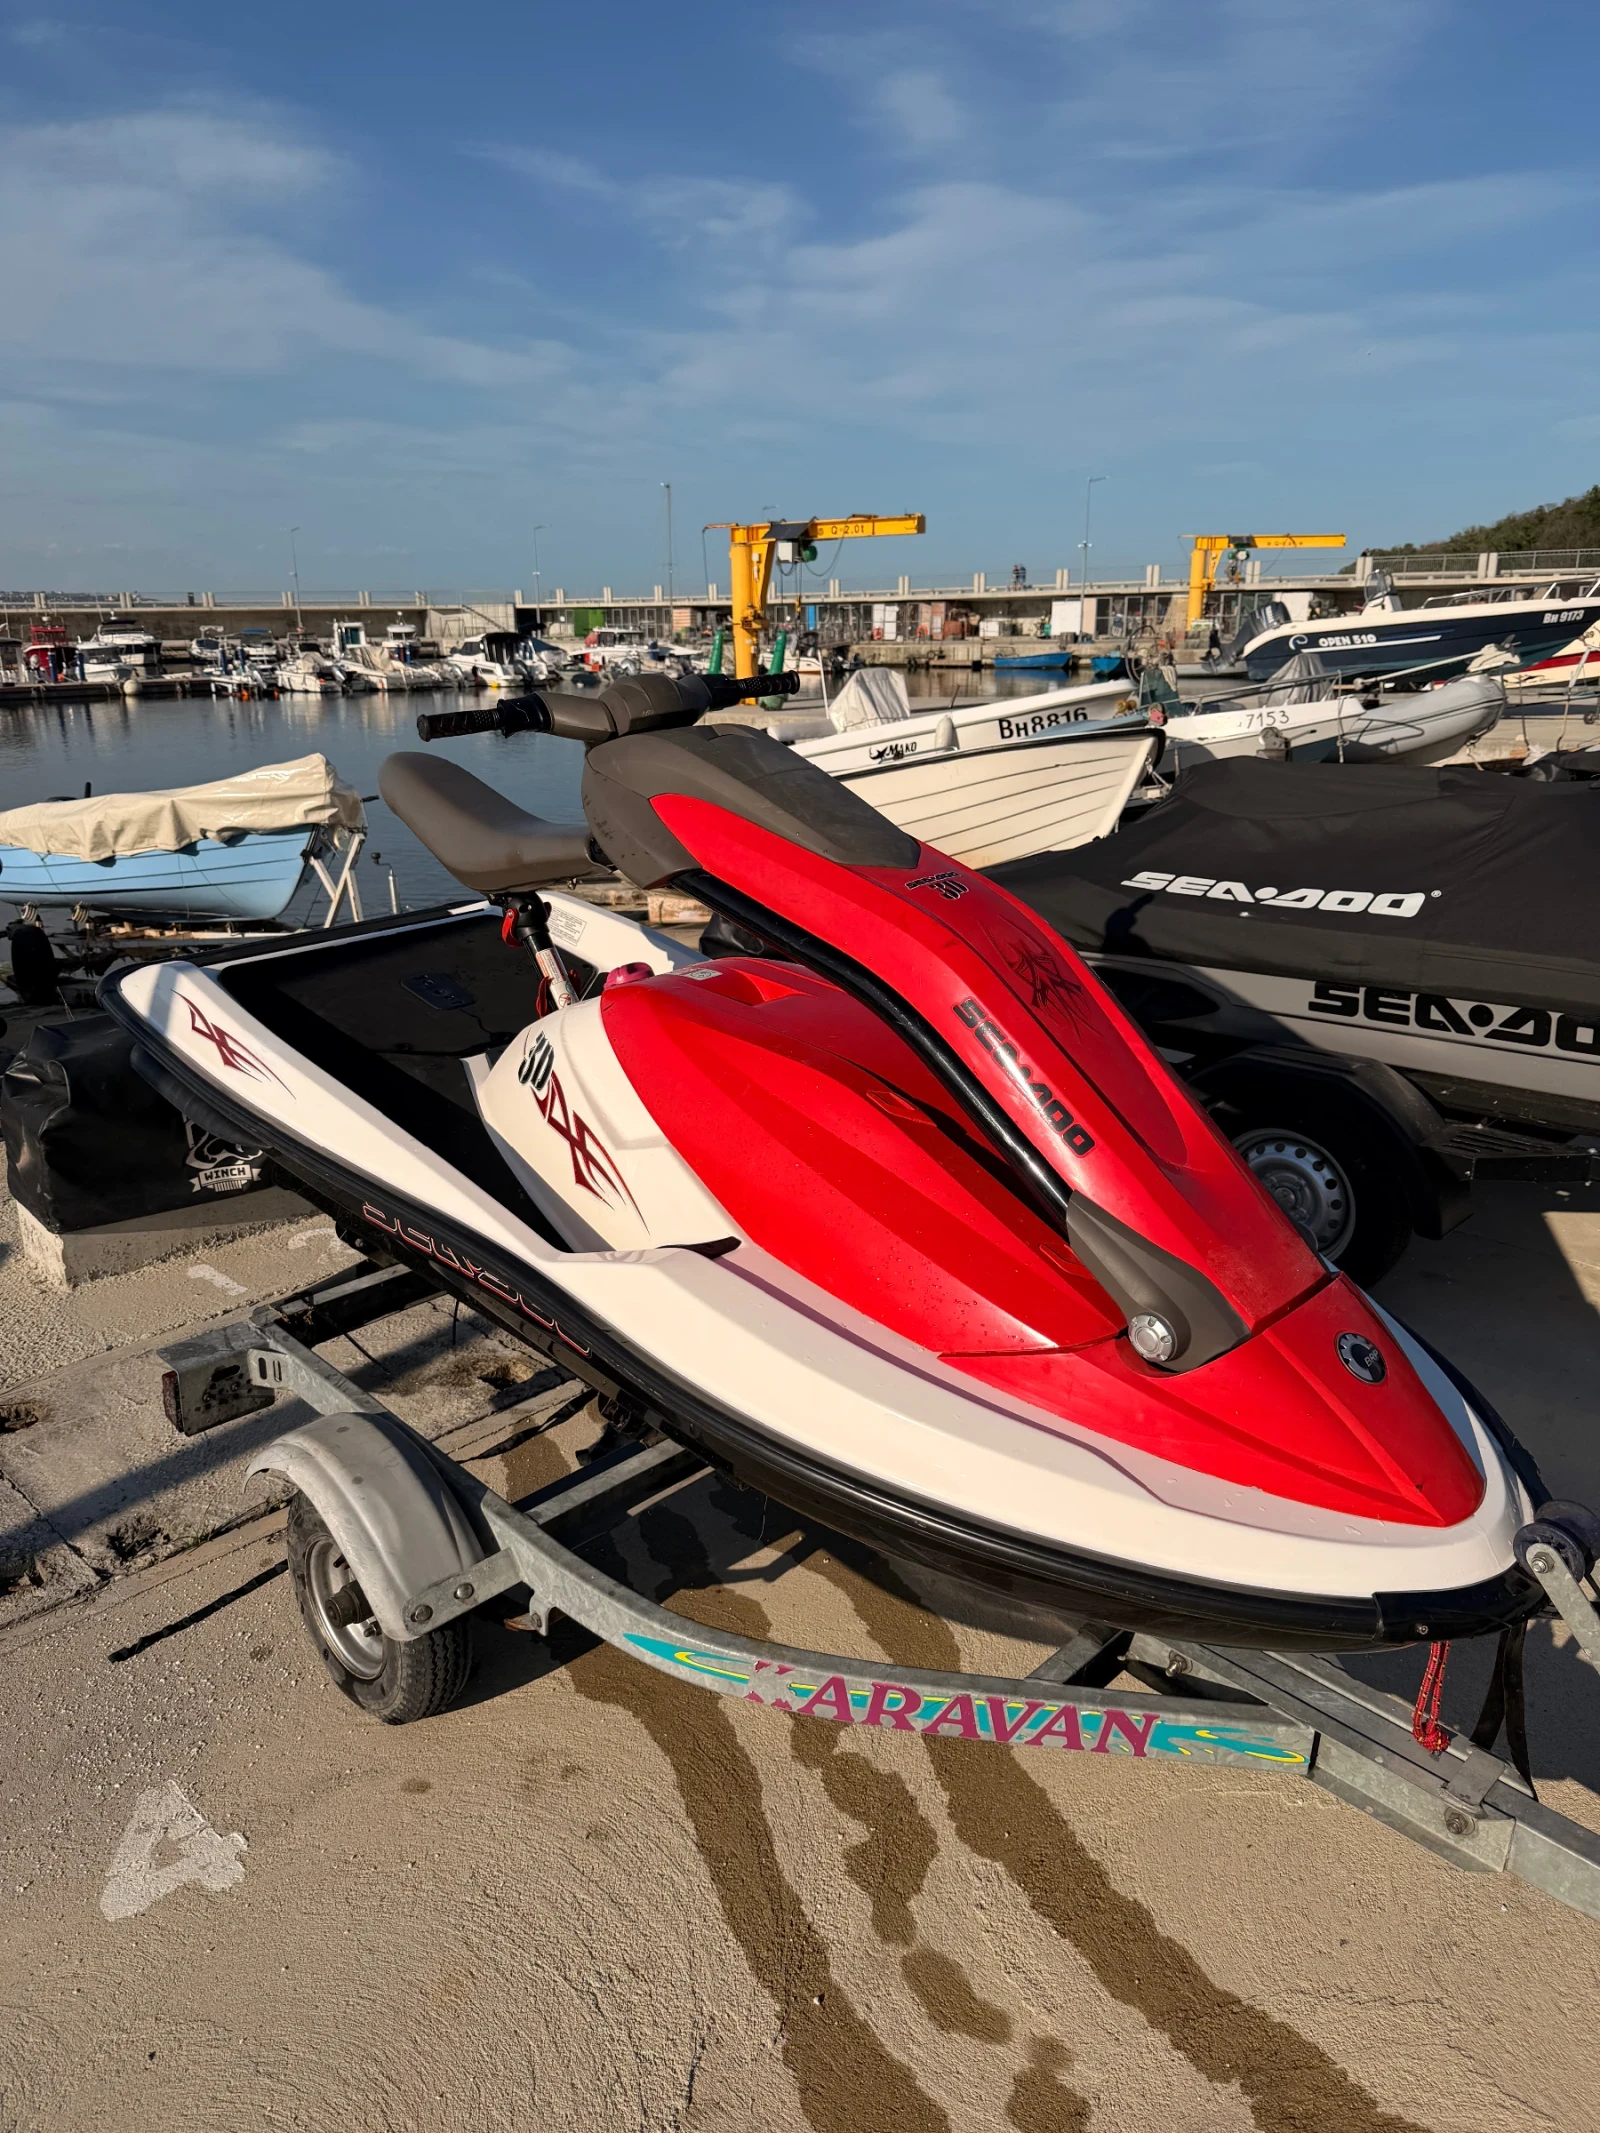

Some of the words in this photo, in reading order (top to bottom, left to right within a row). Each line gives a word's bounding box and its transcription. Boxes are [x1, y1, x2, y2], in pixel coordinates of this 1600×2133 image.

[1559, 610, 1585, 622] 9173
[1318, 636, 1351, 647] OPEN
[1352, 634, 1377, 644] 510
[1246, 710, 1290, 729] 7153
[204, 1166, 247, 1182] WINCH
[1364, 1349, 1380, 1367] BRP
